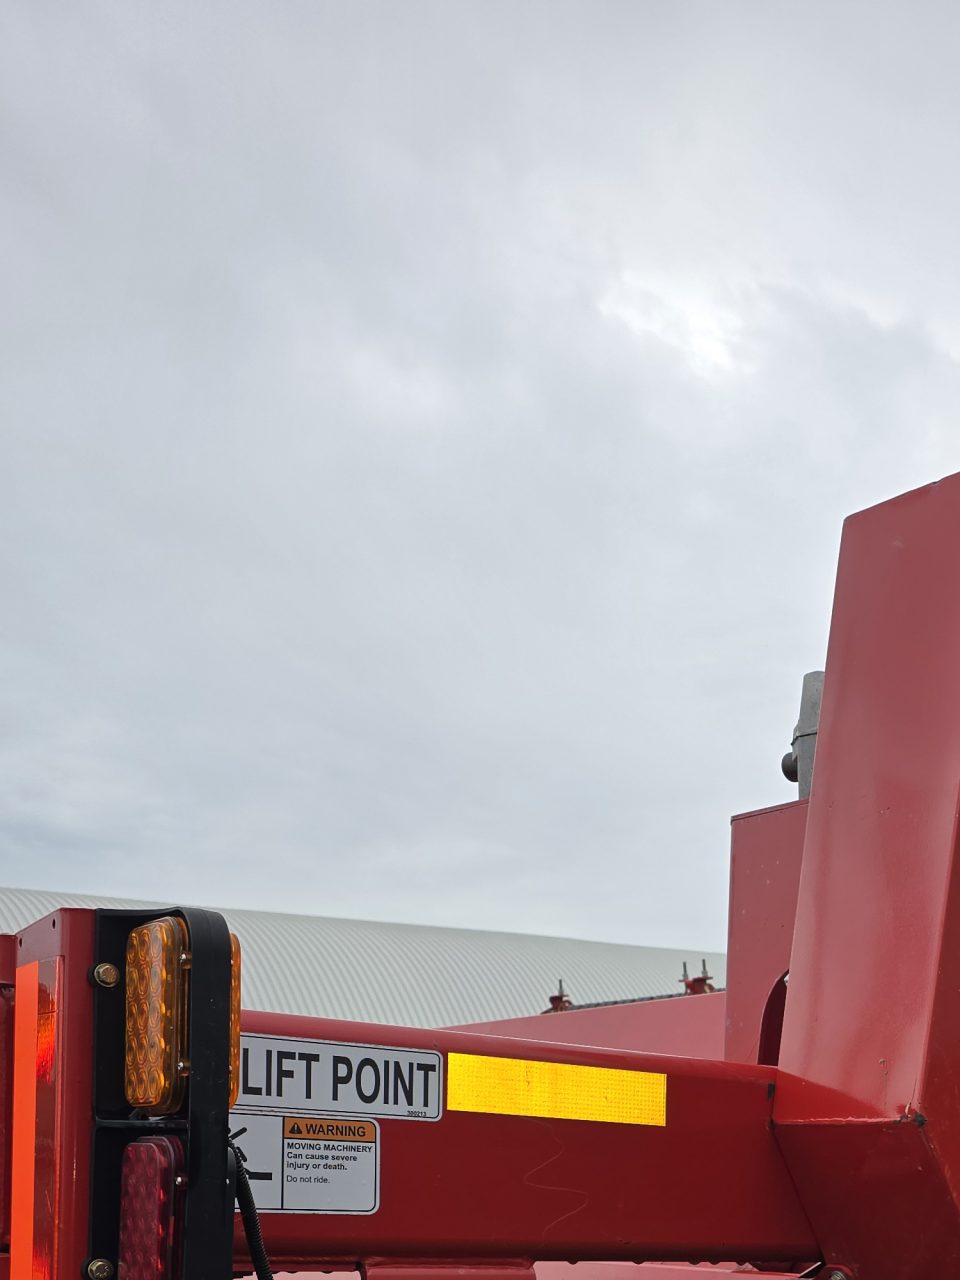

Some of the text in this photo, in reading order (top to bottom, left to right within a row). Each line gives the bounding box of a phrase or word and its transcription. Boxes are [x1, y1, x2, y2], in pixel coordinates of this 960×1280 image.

[242, 1047, 437, 1108] LIFT POINT
[305, 1123, 366, 1137] WARNING
[287, 1142, 373, 1153] MOVING MACHINERY
[287, 1151, 303, 1160] Can
[305, 1153, 329, 1161] cause
[286, 1161, 310, 1171] injury
[323, 1163, 348, 1171] death.
[286, 1175, 298, 1183] Do
[313, 1176, 331, 1184] ride.
